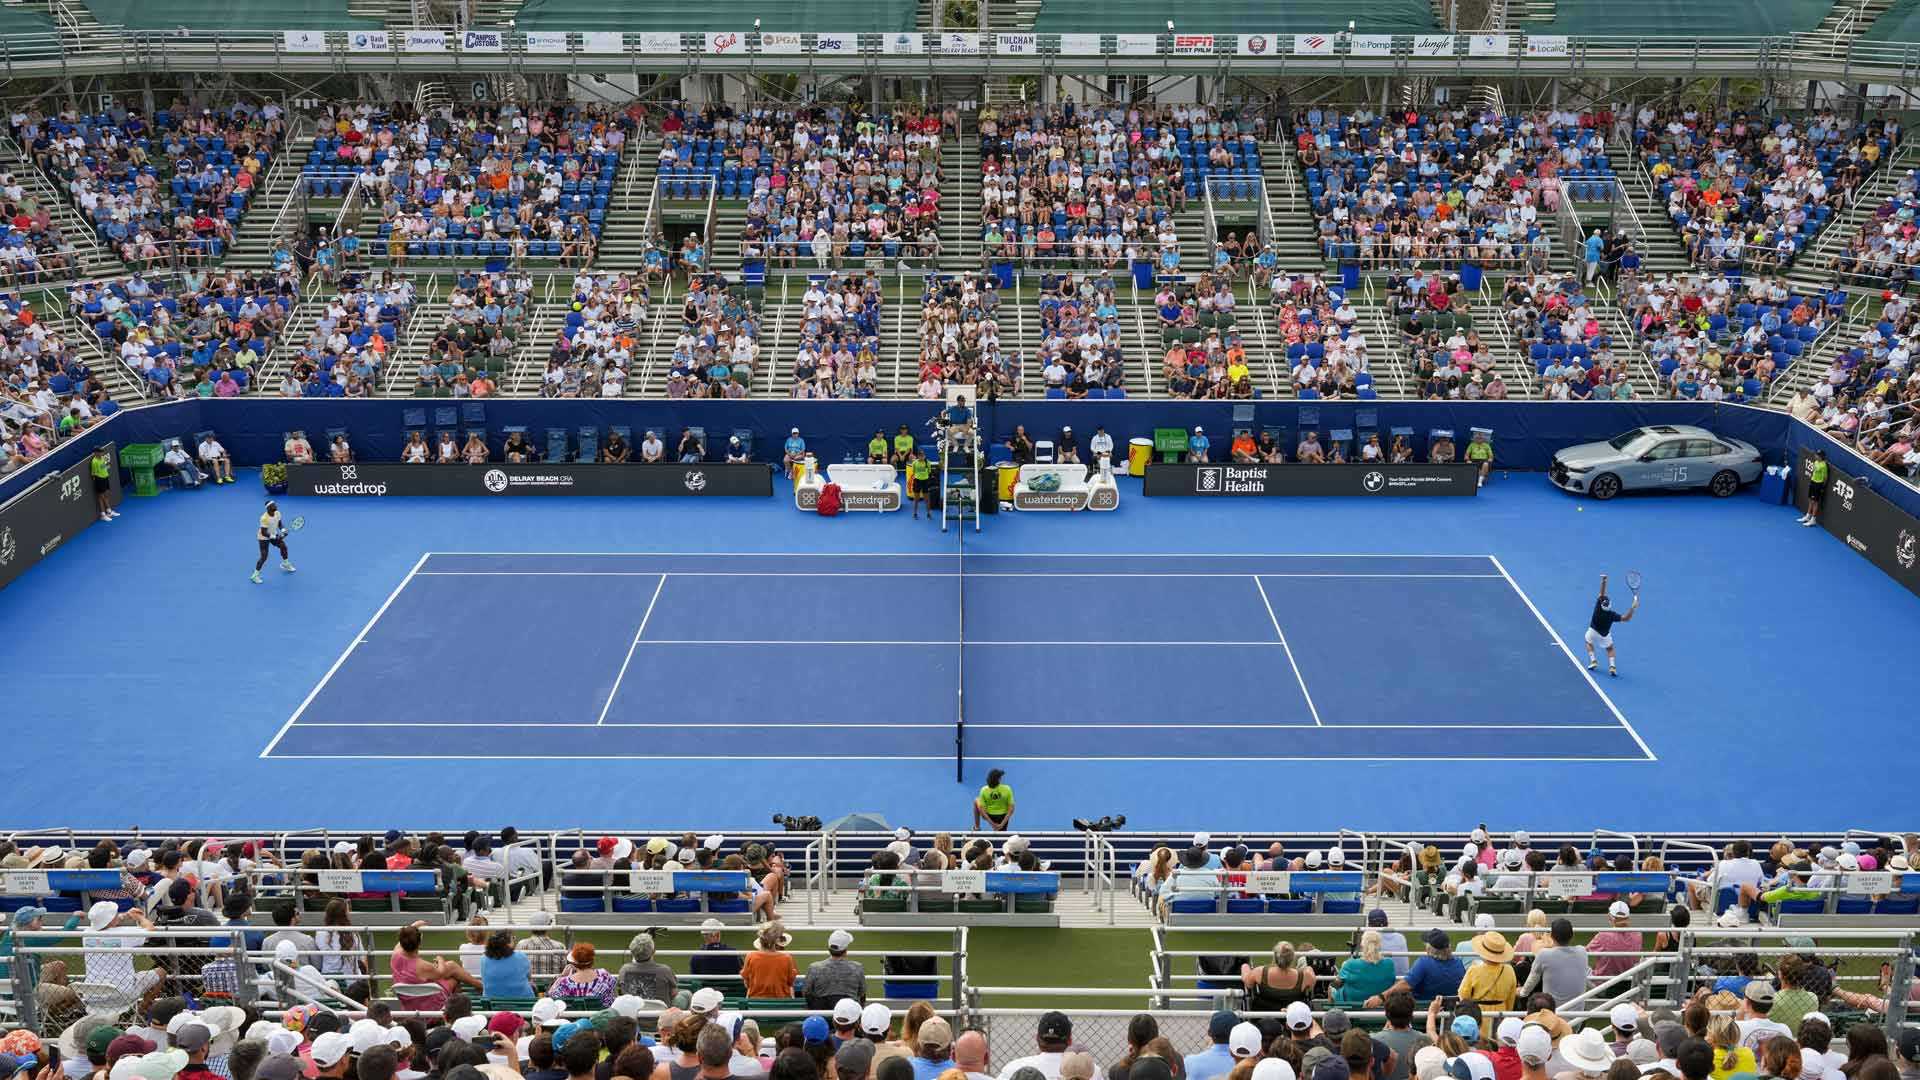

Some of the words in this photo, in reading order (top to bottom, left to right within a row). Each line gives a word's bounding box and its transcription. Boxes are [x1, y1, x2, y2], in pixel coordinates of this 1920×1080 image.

[372, 42, 387, 50] Travel
[775, 36, 799, 46] PGA
[819, 38, 842, 50] abs
[1000, 36, 1034, 45] TULCHAN
[1176, 37, 1213, 47] ESPN
[1352, 41, 1365, 49] The
[1367, 41, 1390, 51] Pomp
[1418, 37, 1450, 55] Jungle
[473, 83, 485, 99] G
[806, 84, 817, 101] H
[1226, 467, 1268, 481] Baptist
[1673, 466, 1688, 482] i5
[60, 475, 80, 501] ATP
[314, 482, 387, 496] waterdrop
[1225, 480, 1264, 492] Health
[1832, 479, 1854, 500] ATP
[1024, 496, 1079, 506] waterdrop
